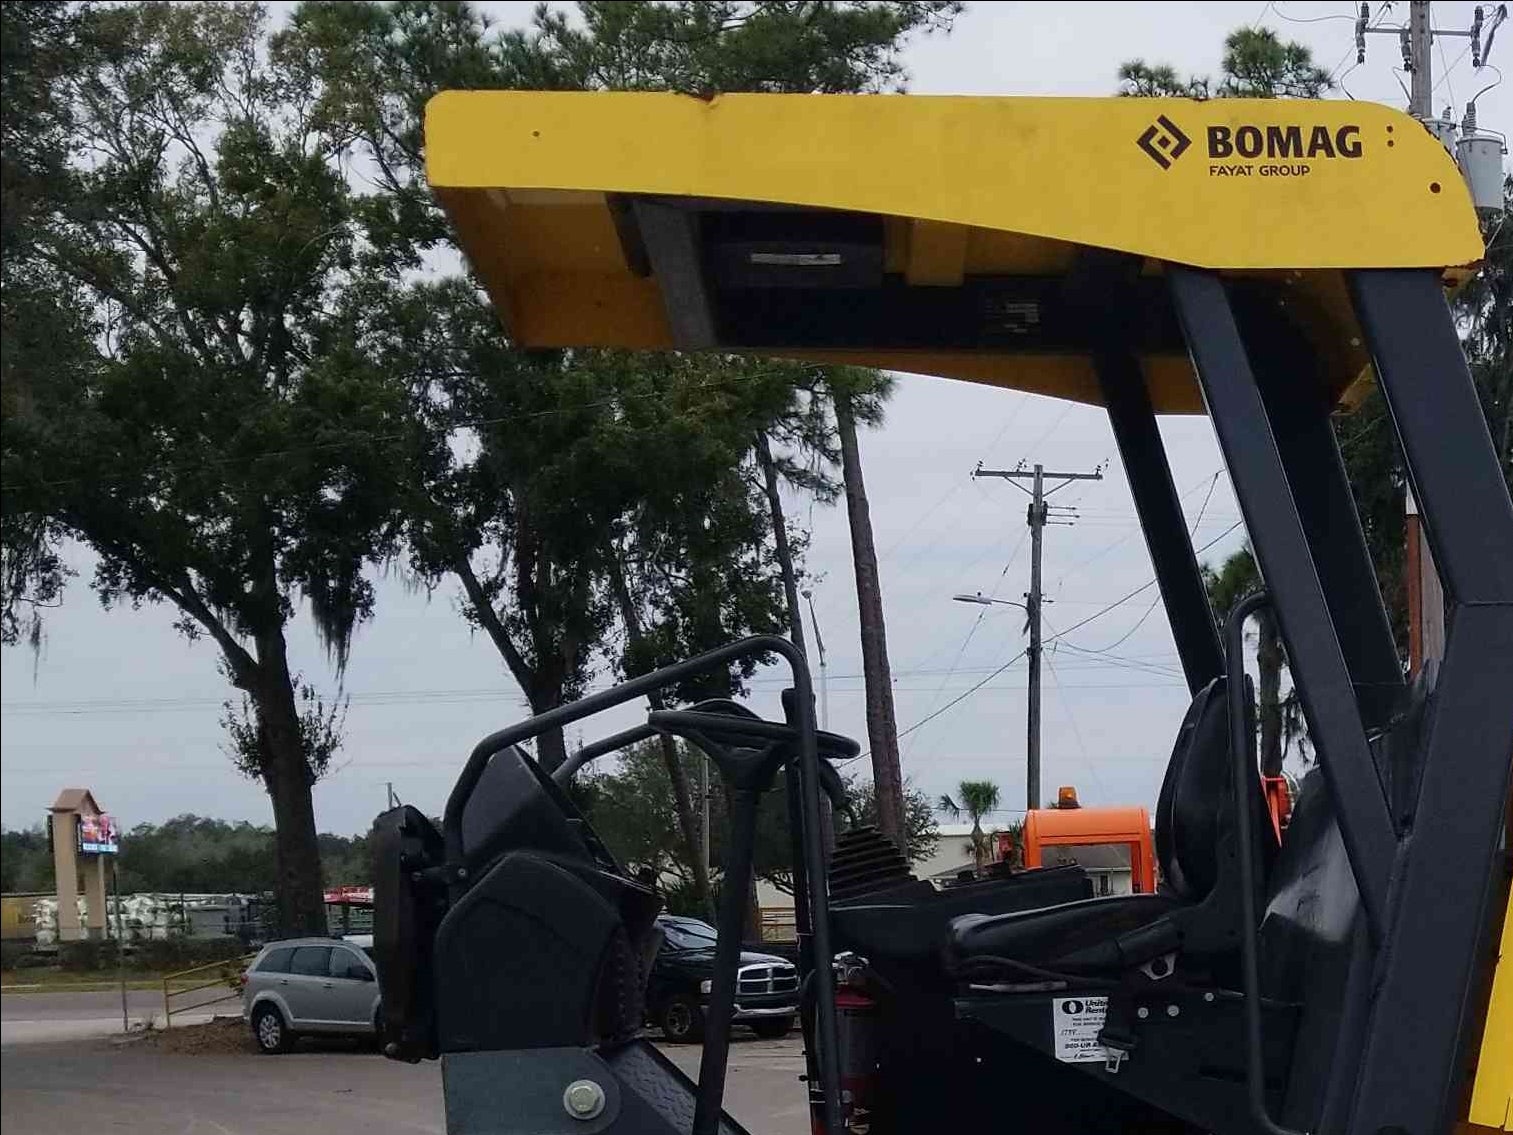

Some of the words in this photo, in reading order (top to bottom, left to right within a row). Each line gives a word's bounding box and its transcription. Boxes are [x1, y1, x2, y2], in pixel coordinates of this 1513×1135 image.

[1207, 125, 1363, 159] BOMAG
[1209, 165, 1254, 177] FAYAT
[1259, 165, 1311, 177] GROUP
